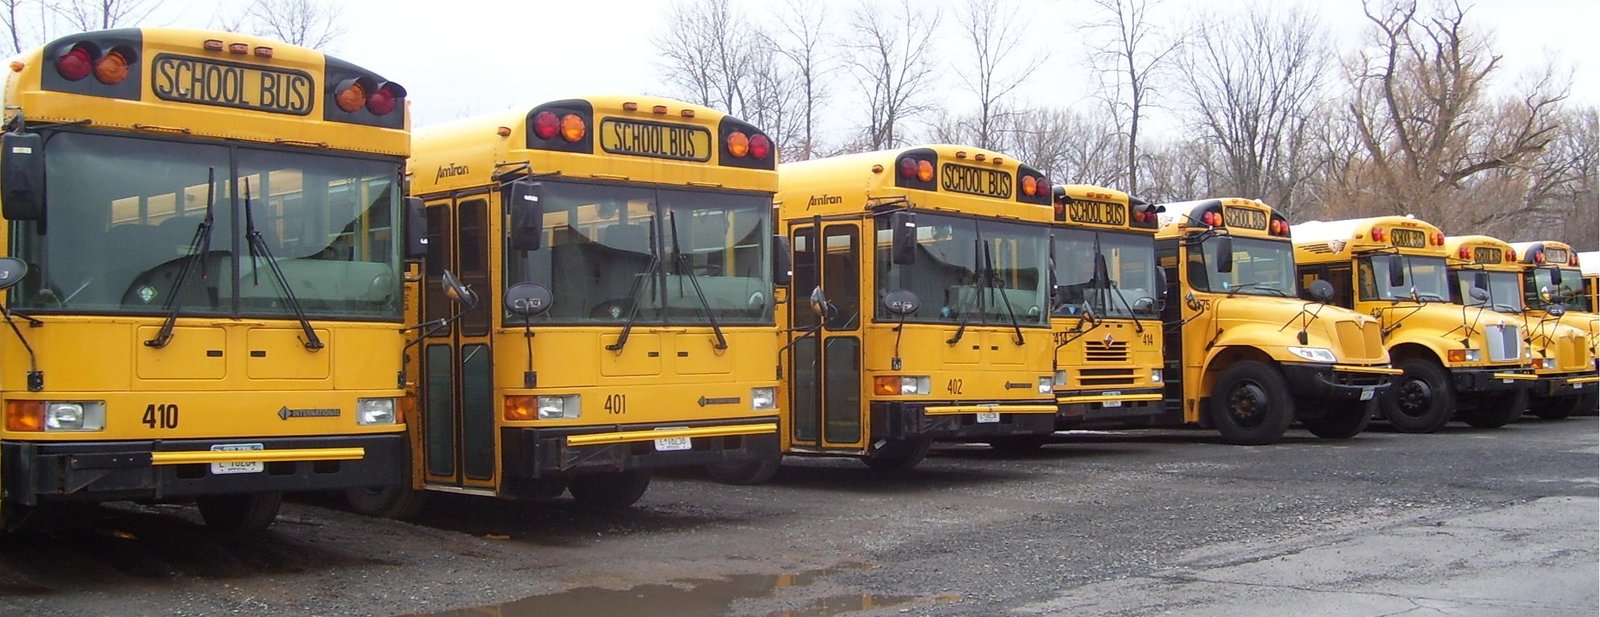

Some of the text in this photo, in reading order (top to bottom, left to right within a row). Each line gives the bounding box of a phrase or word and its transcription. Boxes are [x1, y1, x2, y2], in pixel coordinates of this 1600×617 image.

[159, 58, 305, 112] SCHOOL BUS
[614, 122, 695, 157] SCHOOL BUS
[434, 162, 469, 185] AmTran
[944, 164, 1009, 196] SCHOOL BUS
[806, 194, 842, 211] AmTran
[1071, 200, 1122, 224] SCHOOL BUS
[1226, 207, 1266, 230] SCHOOL BUS
[1142, 333, 1153, 346] 414
[947, 378, 962, 394] 402
[142, 403, 178, 429] 410
[604, 394, 626, 415] 401
